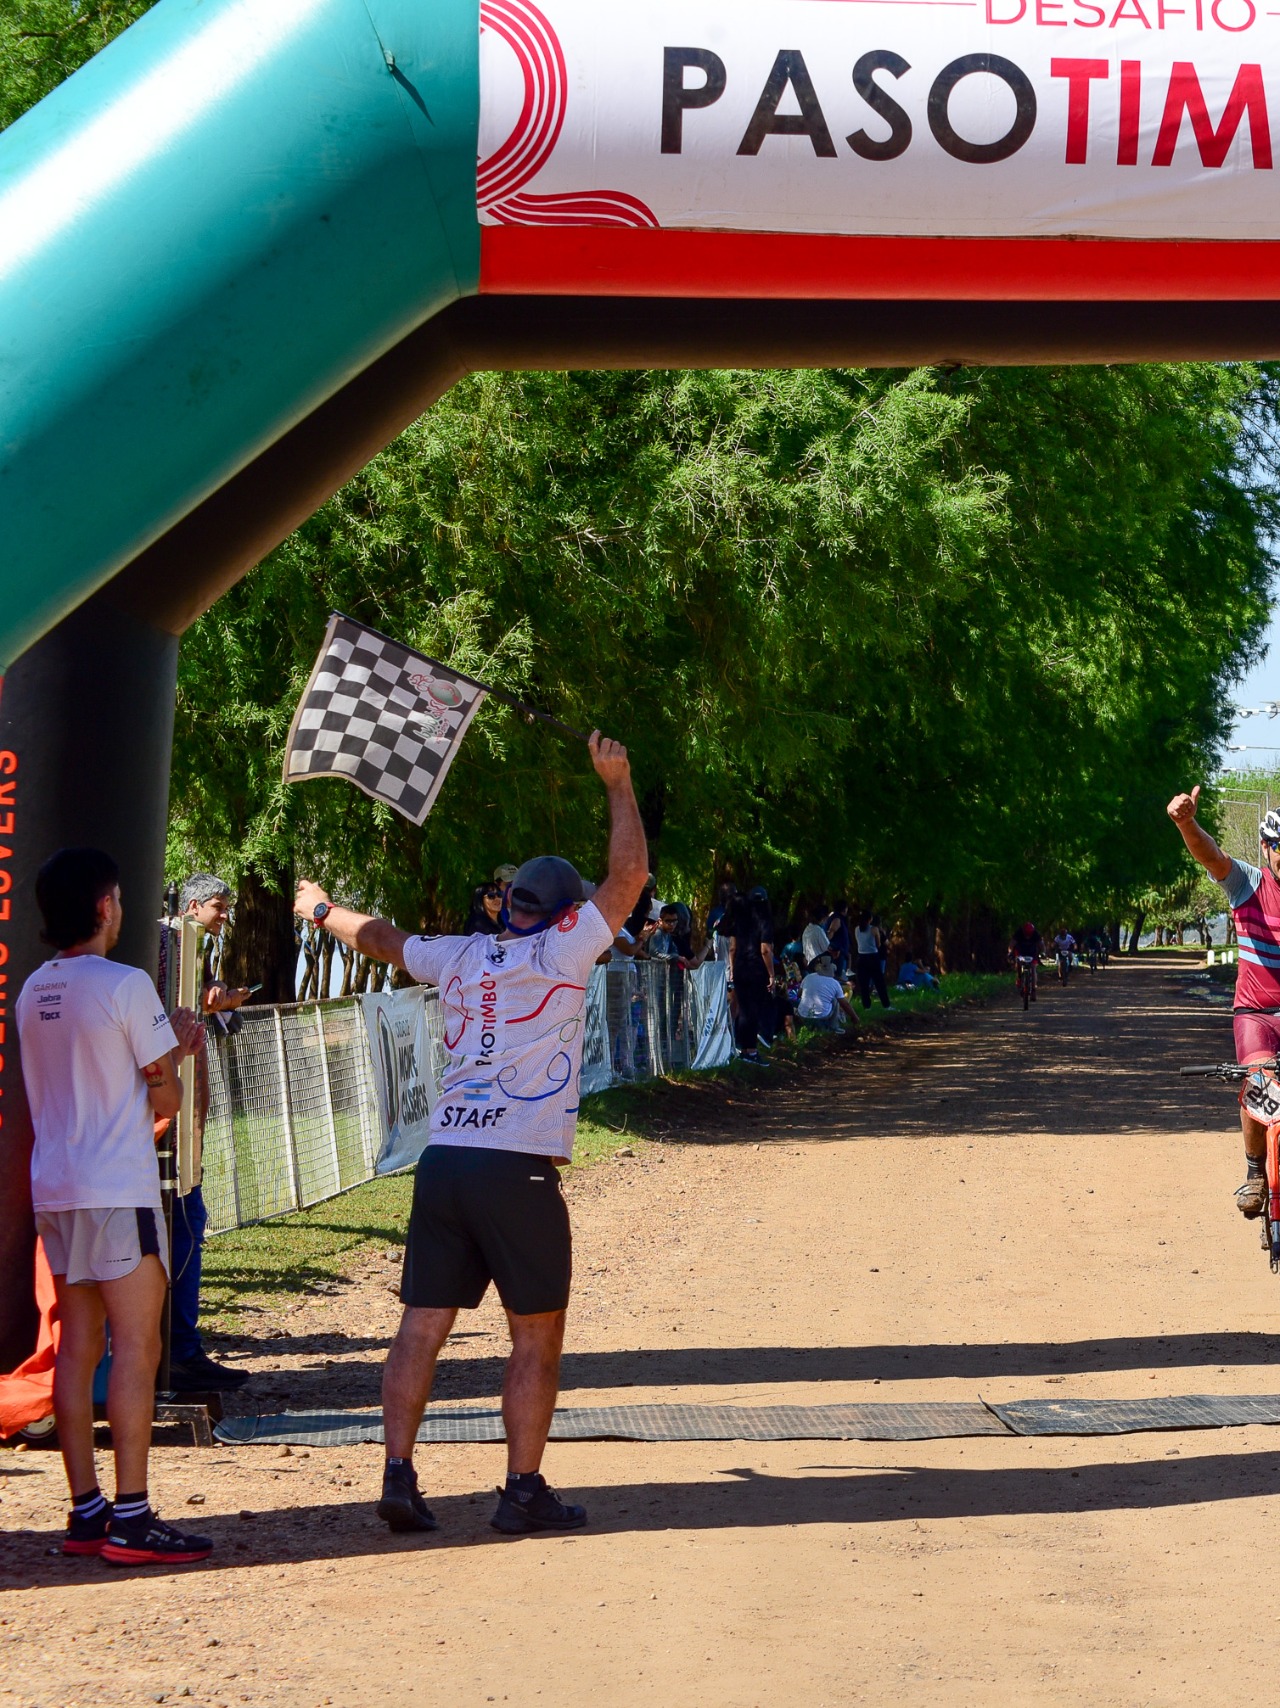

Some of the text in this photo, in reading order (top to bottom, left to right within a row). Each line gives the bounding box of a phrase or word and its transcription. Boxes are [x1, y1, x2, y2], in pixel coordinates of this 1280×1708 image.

[33, 981, 68, 992] GARMIN
[39, 1011, 62, 1022] Tacx
[440, 1106, 507, 1128] STAFF
